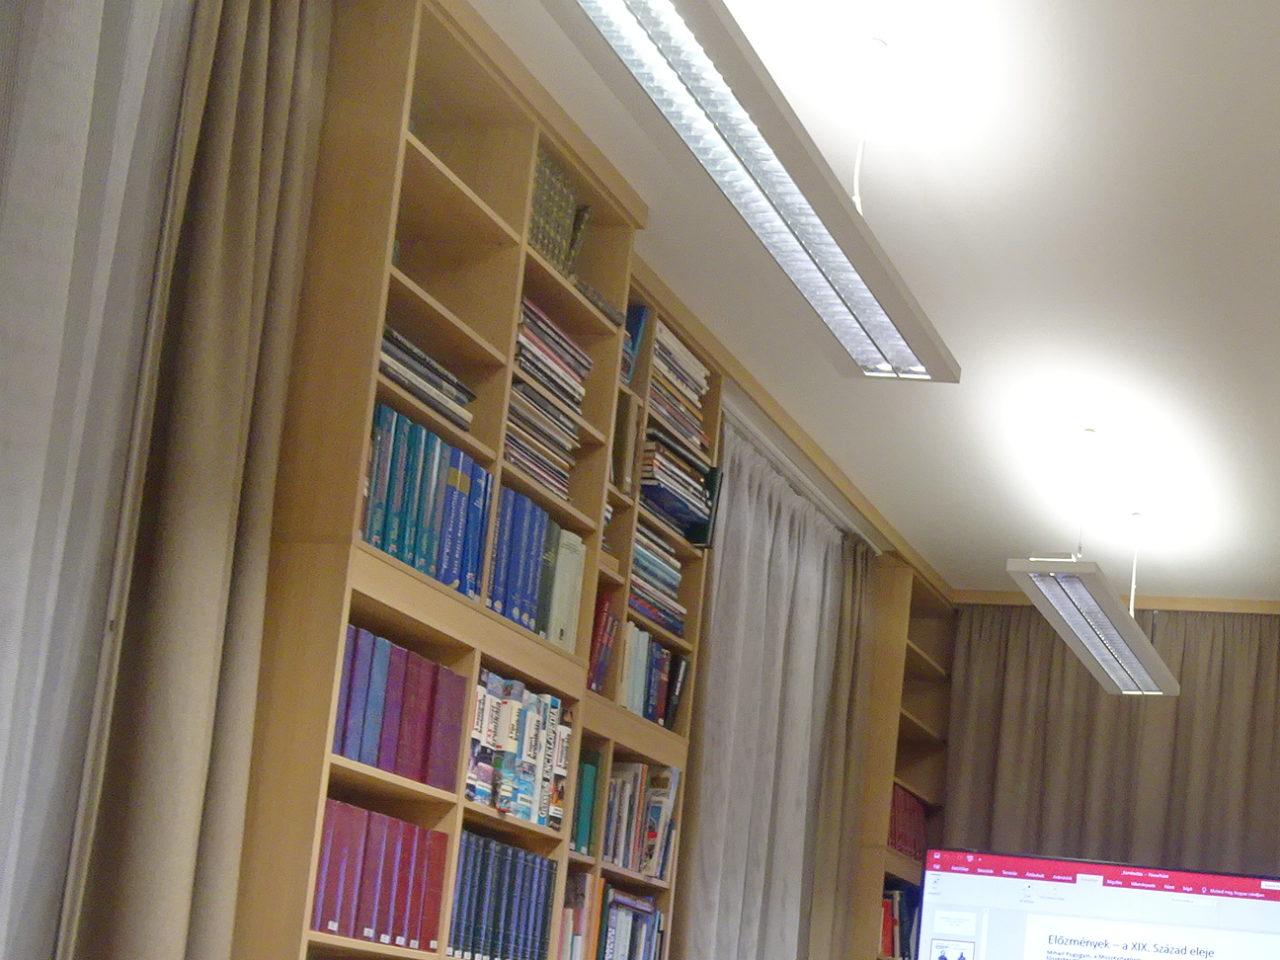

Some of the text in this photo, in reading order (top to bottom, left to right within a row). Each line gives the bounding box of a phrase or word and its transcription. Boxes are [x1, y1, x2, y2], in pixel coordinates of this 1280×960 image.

[1048, 934, 1109, 949] Előzmények
[1131, 942, 1150, 952] XIX.
[1153, 943, 1187, 956] Század
[1189, 947, 1215, 959] eleje
